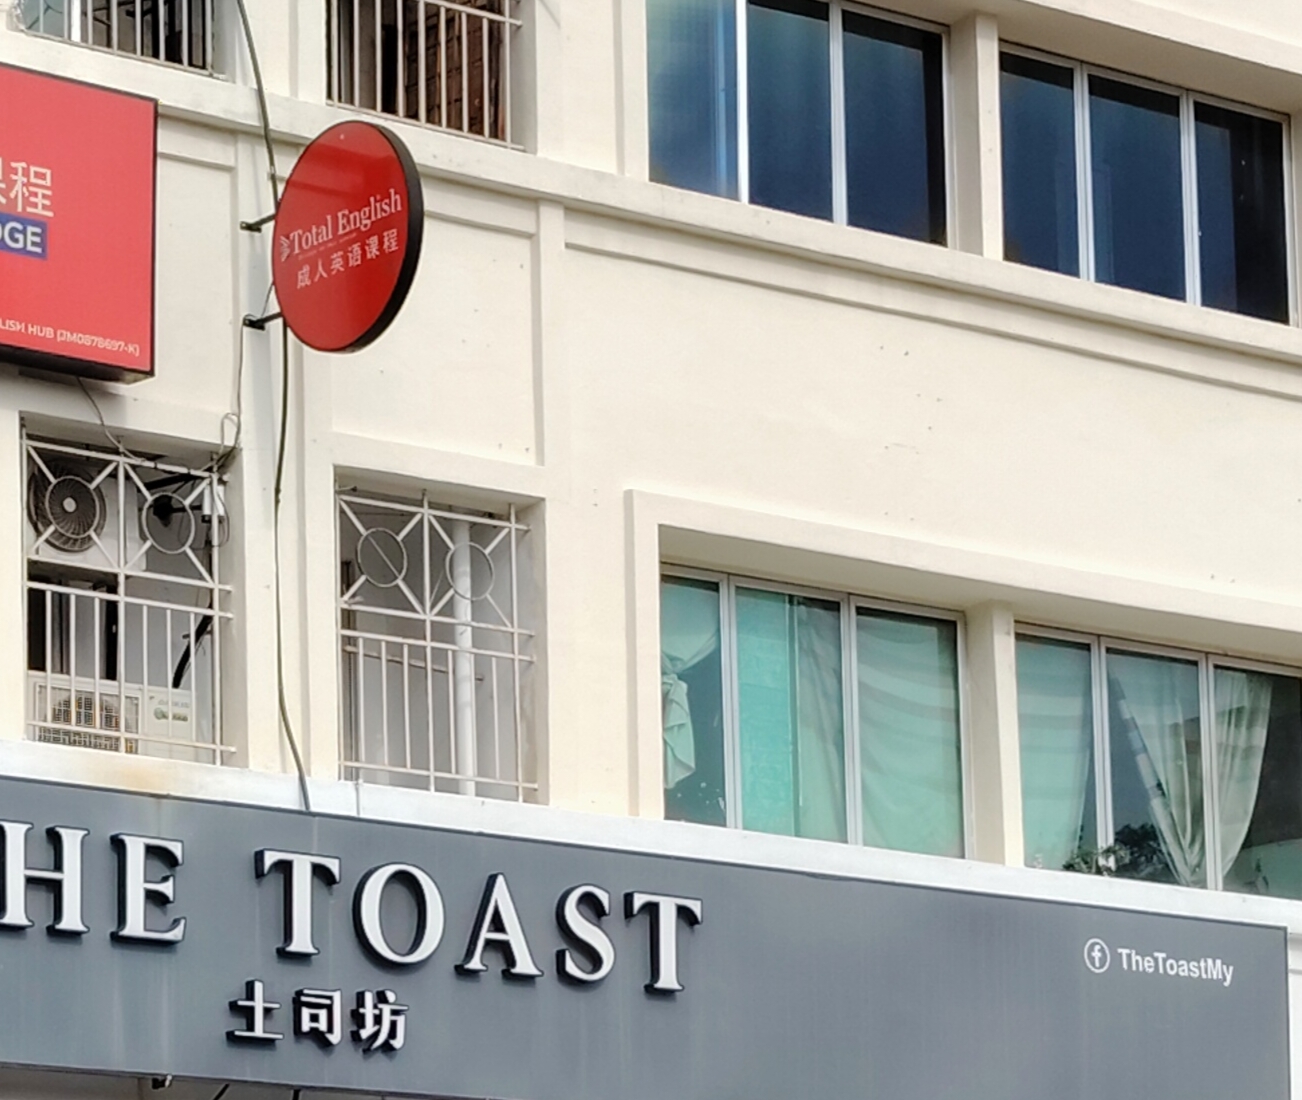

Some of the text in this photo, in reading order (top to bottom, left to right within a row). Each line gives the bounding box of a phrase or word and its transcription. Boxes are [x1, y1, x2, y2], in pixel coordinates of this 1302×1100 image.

[290, 215, 334, 255] Total
[337, 188, 403, 236] English
[296, 228, 400, 289] 成人英语课程
[27, 324, 55, 339] HUB
[254, 849, 703, 994] TOAST
[1117, 948, 1233, 987] TheToastMy
[226, 979, 409, 1056] 土司坊
